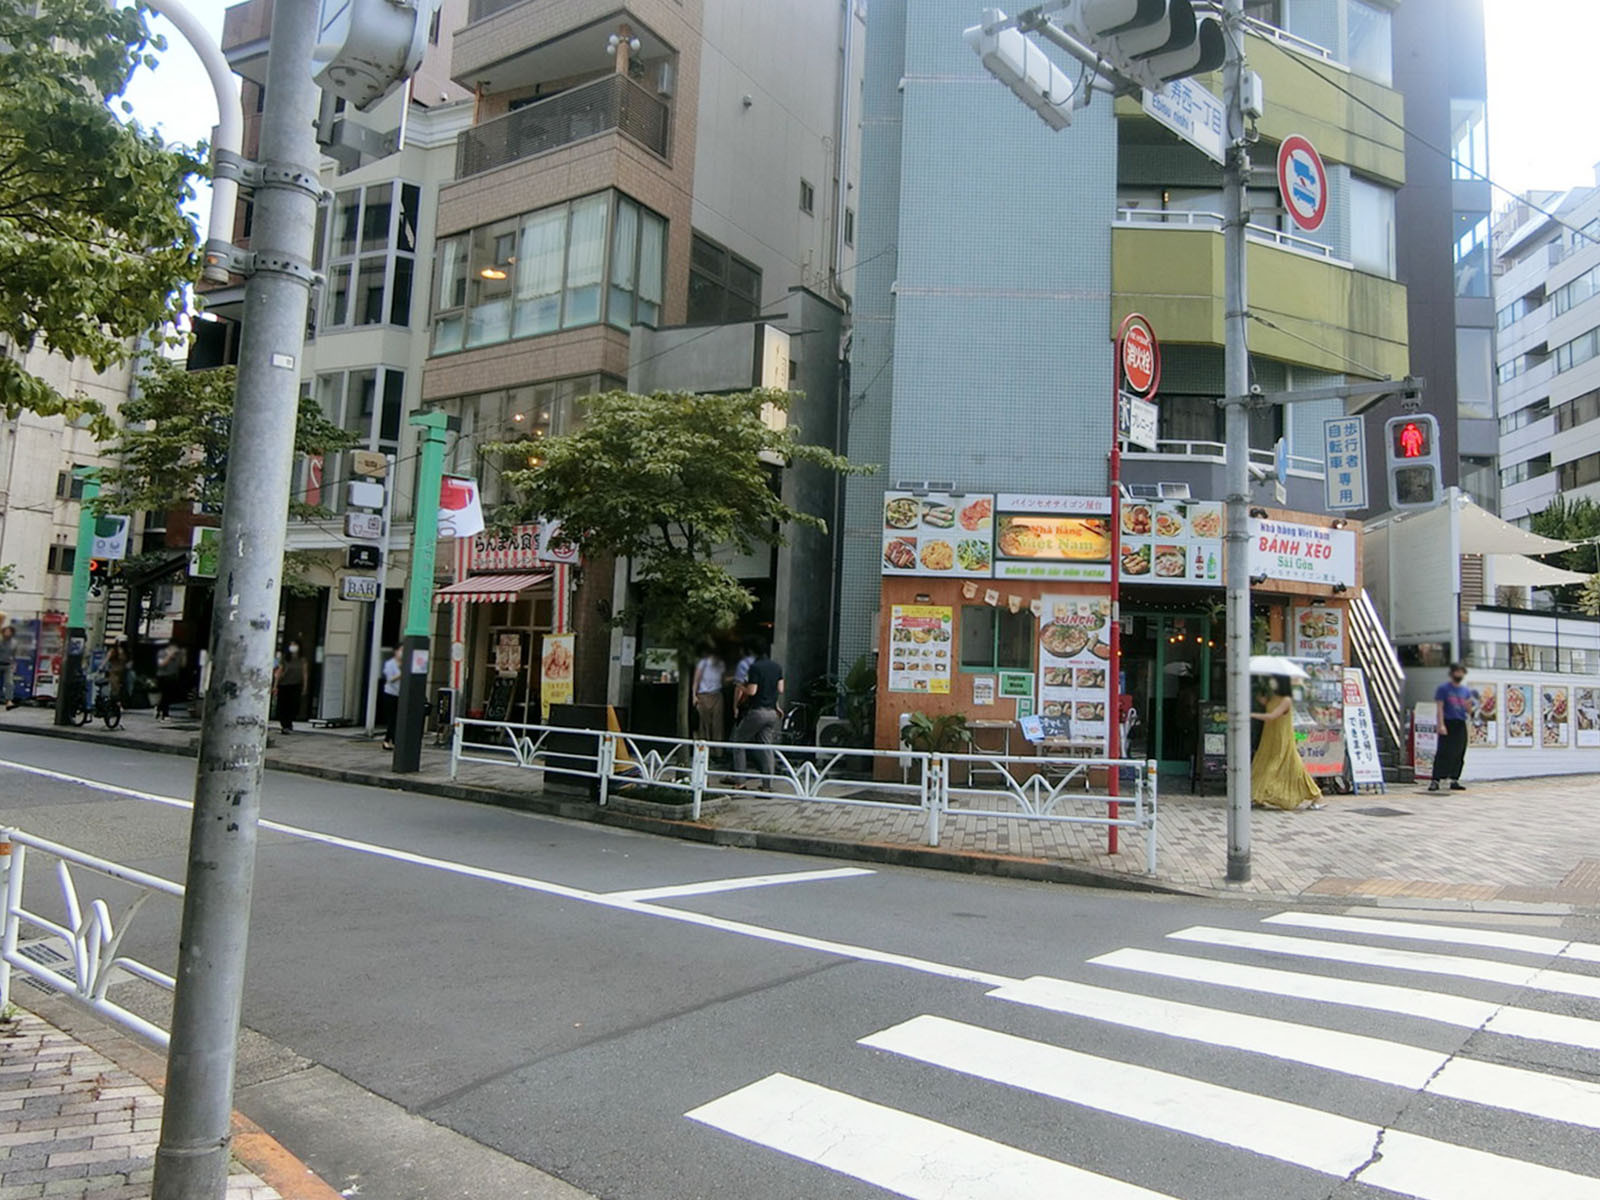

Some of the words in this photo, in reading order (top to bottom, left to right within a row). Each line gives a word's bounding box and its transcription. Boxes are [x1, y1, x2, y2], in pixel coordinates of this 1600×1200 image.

[1127, 342, 1151, 376] 消火栓
[1328, 424, 1343, 469] 自転車
[1344, 423, 1360, 468] 歩行者
[1339, 472, 1354, 503] 専用
[348, 582, 375, 595] BAR
[1056, 615, 1096, 627] LUNCH
